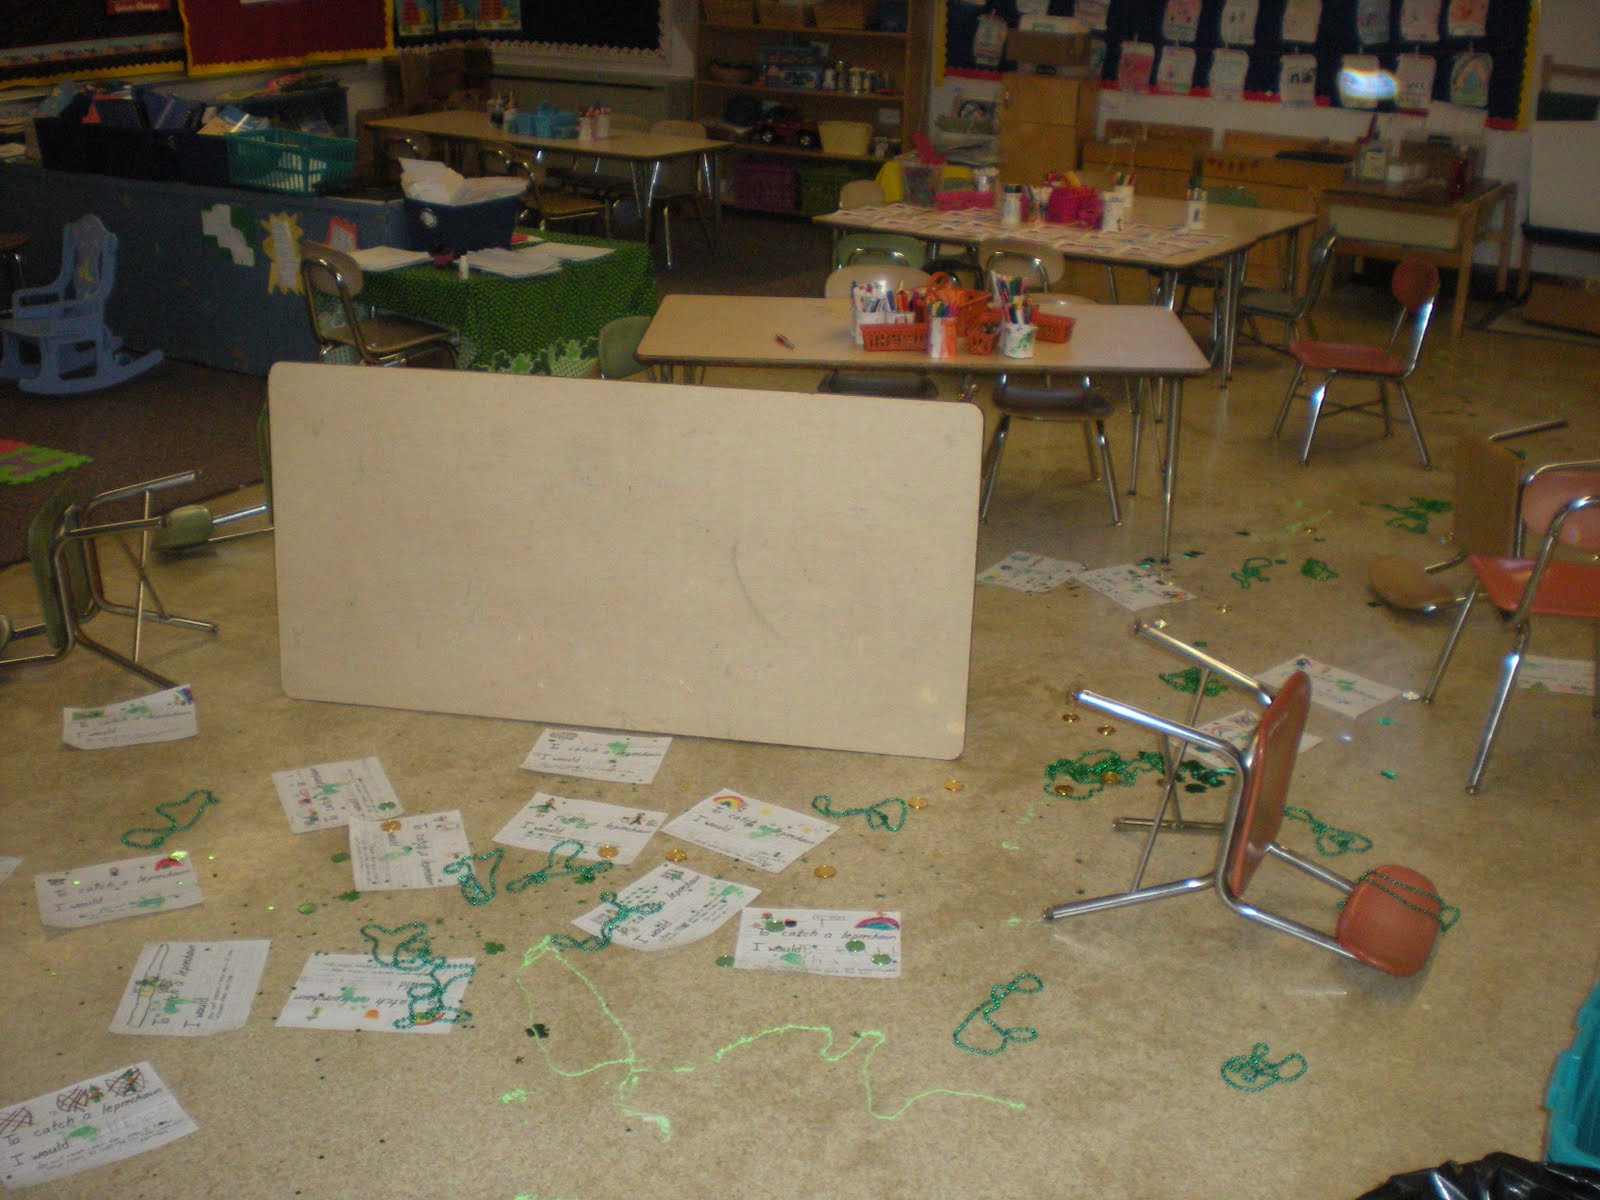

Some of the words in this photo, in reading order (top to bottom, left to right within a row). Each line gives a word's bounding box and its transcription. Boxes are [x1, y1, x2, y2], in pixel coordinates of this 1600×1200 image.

[781, 928, 819, 938] catch
[34, 1116, 75, 1137] catch
[101, 1086, 164, 1115] leprechaun
[10, 1152, 25, 1167] I
[32, 1138, 70, 1161] would
